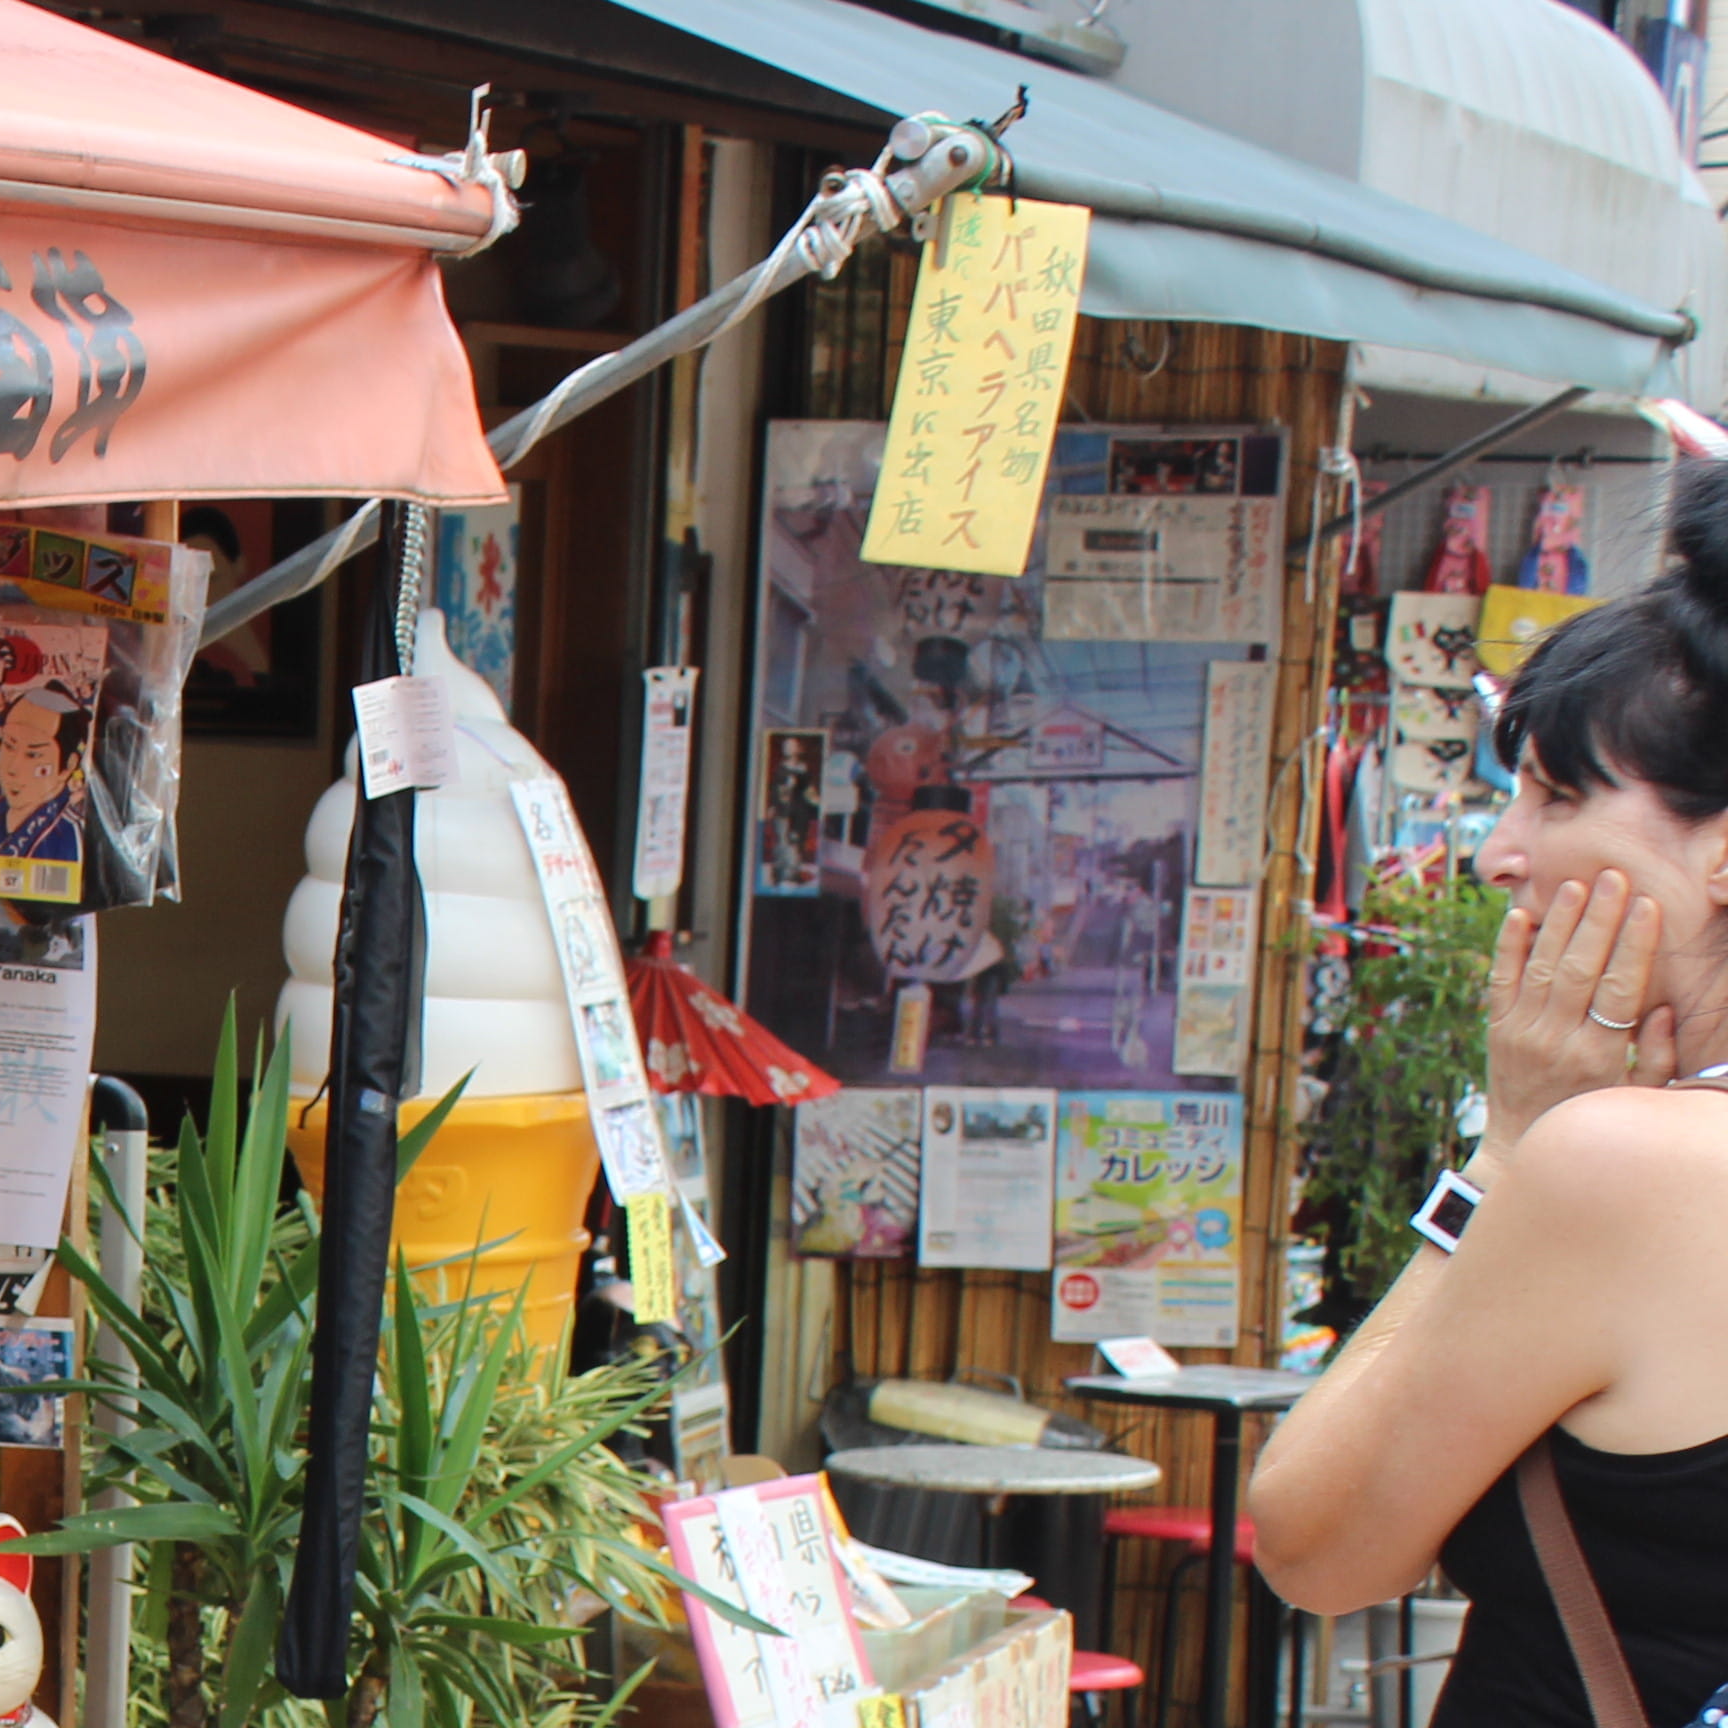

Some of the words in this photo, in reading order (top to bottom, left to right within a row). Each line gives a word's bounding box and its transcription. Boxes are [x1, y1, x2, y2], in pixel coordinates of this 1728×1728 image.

[1001, 245, 1079, 485] 秋田県名物
[1098, 1153, 1228, 1185] カレッジ
